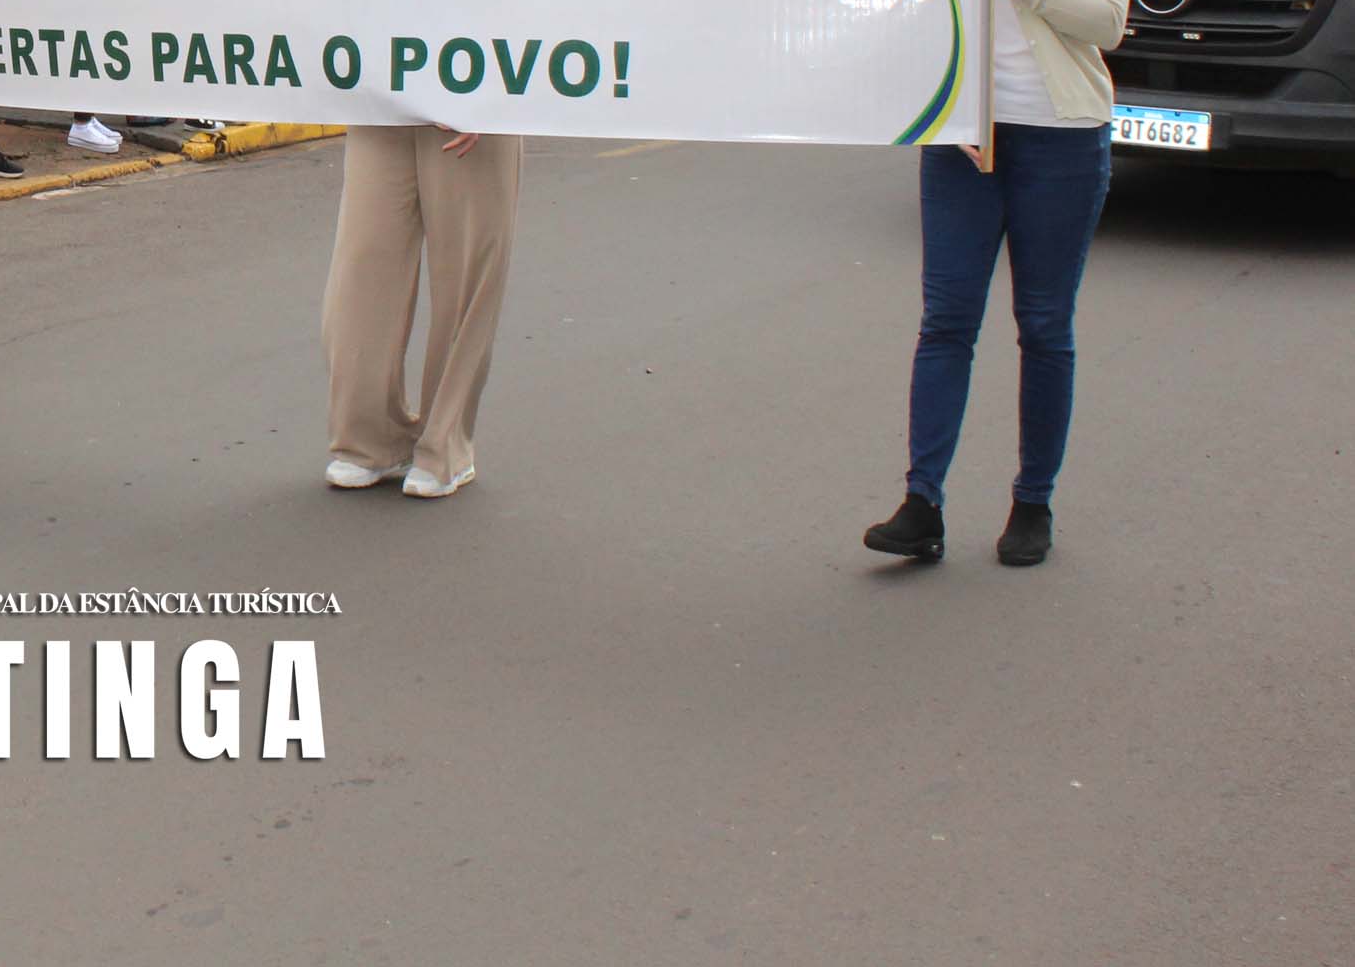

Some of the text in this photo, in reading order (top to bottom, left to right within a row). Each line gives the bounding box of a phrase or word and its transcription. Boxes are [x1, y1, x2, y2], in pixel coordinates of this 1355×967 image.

[151, 31, 303, 89] PARA
[322, 34, 362, 91] O
[390, 36, 631, 99] POVO!
